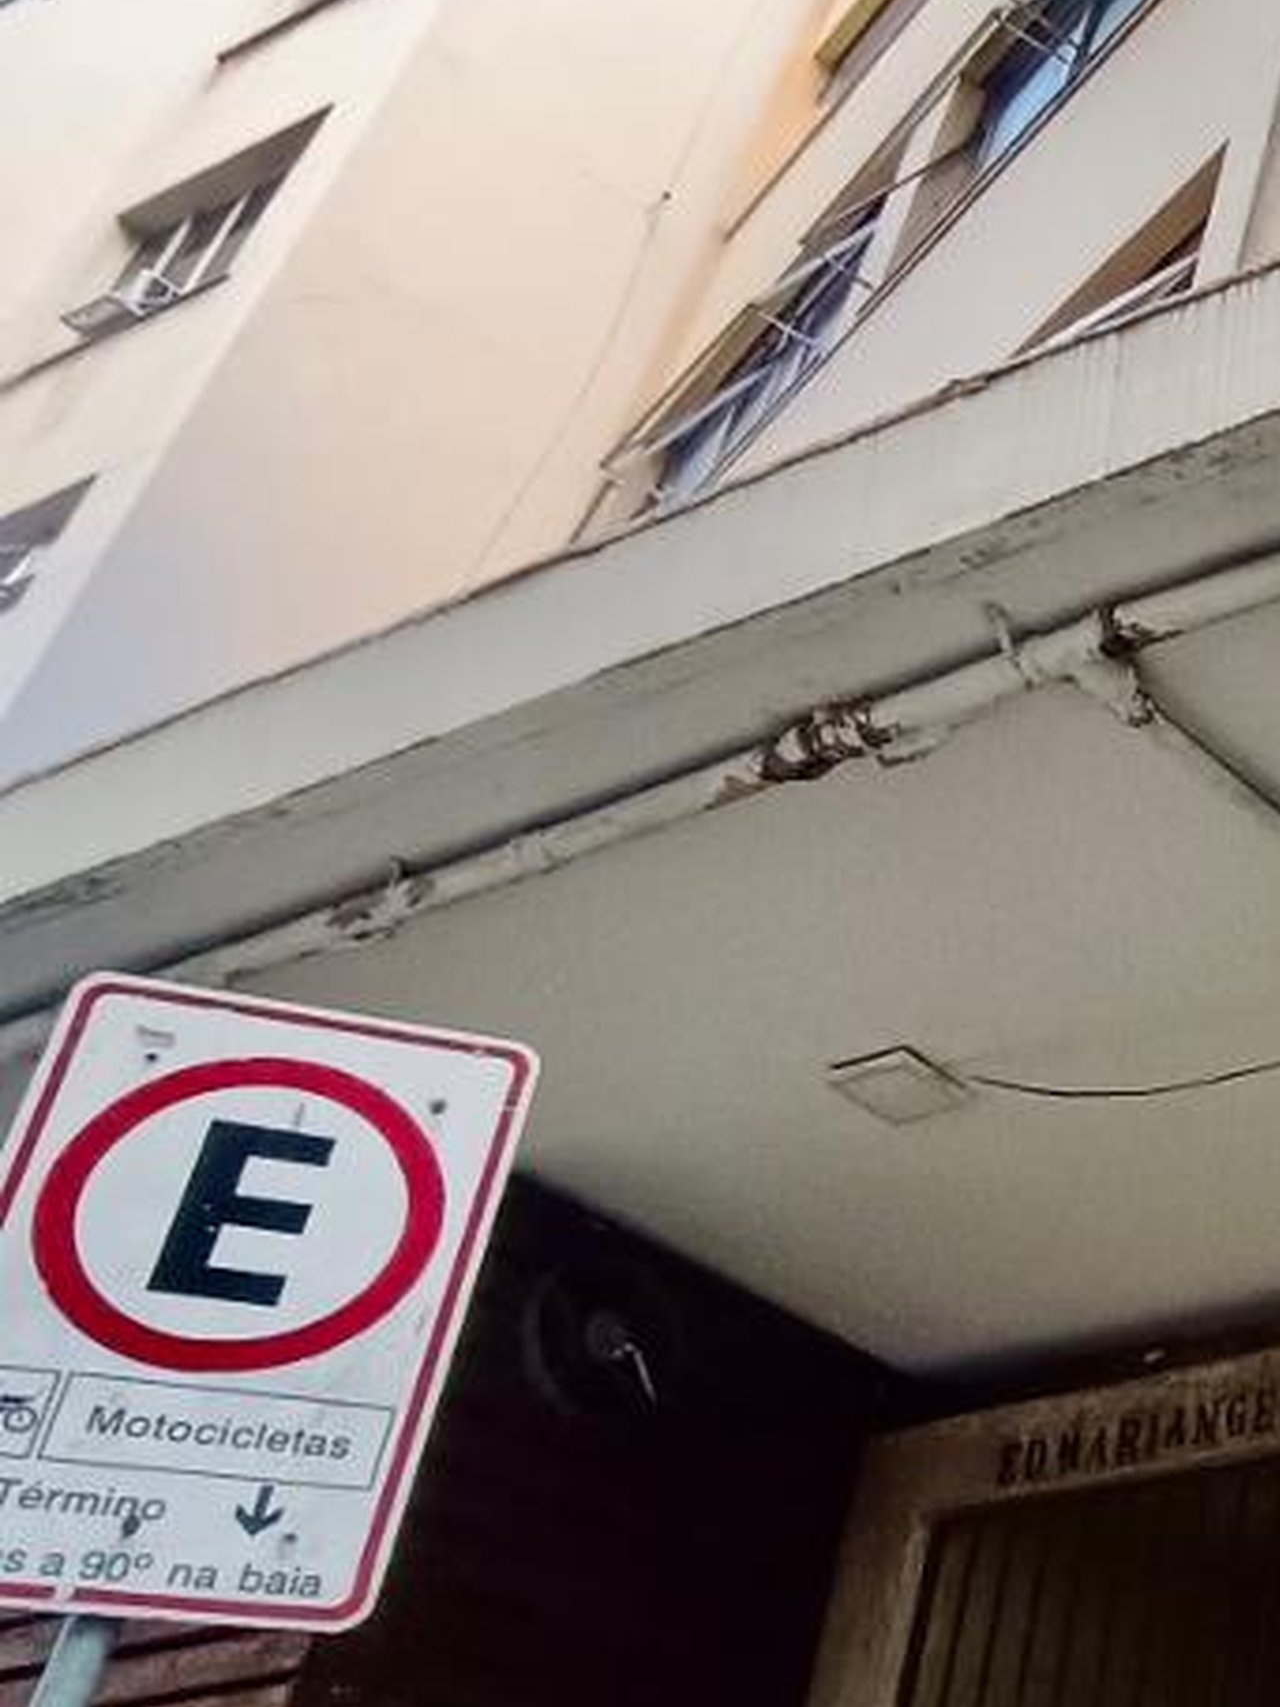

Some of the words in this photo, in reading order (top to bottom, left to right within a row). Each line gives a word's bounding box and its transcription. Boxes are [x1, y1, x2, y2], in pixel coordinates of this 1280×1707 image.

[145, 1118, 336, 1307] E
[85, 1405, 352, 1461] Motocicletas
[41, 1550, 66, 1578] a
[167, 1562, 218, 1592] na
[239, 1562, 322, 1597] baia
